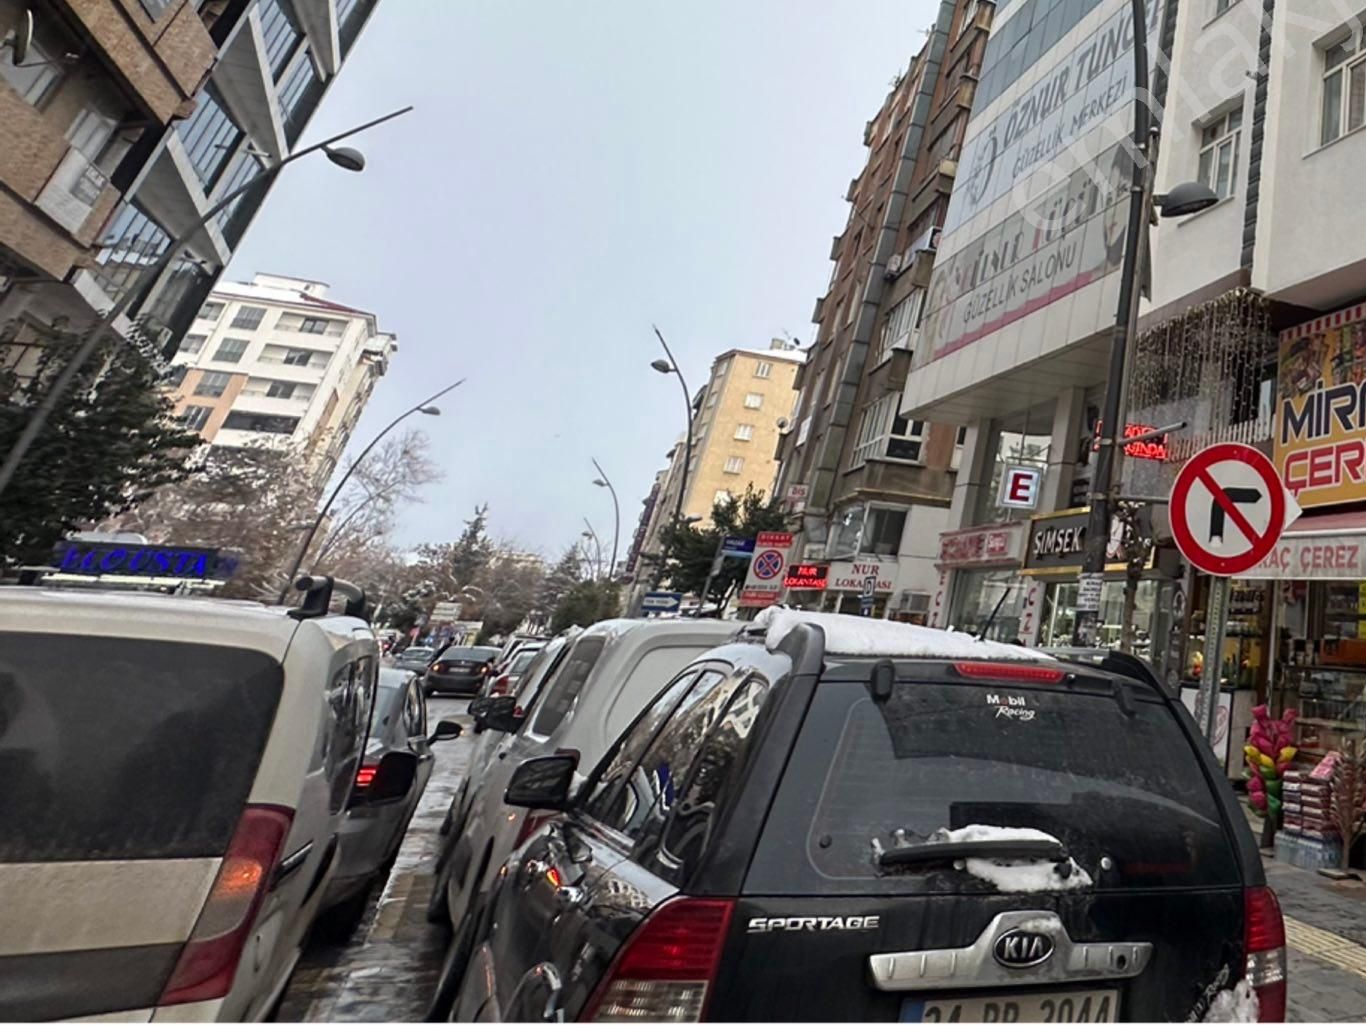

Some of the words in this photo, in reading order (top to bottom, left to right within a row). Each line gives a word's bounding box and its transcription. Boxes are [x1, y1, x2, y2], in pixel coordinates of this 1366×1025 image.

[1019, 241, 1077, 294] SALONU
[1008, 472, 1033, 502] E
[1300, 545, 1360, 571] ÇEREZ
[851, 564, 880, 576] NUR
[835, 578, 892, 591] LOKAASI
[986, 693, 1026, 707] Mobil
[993, 705, 1037, 721] Racing
[747, 915, 880, 934] SPORTAGE
[1001, 935, 1045, 961] KIA
